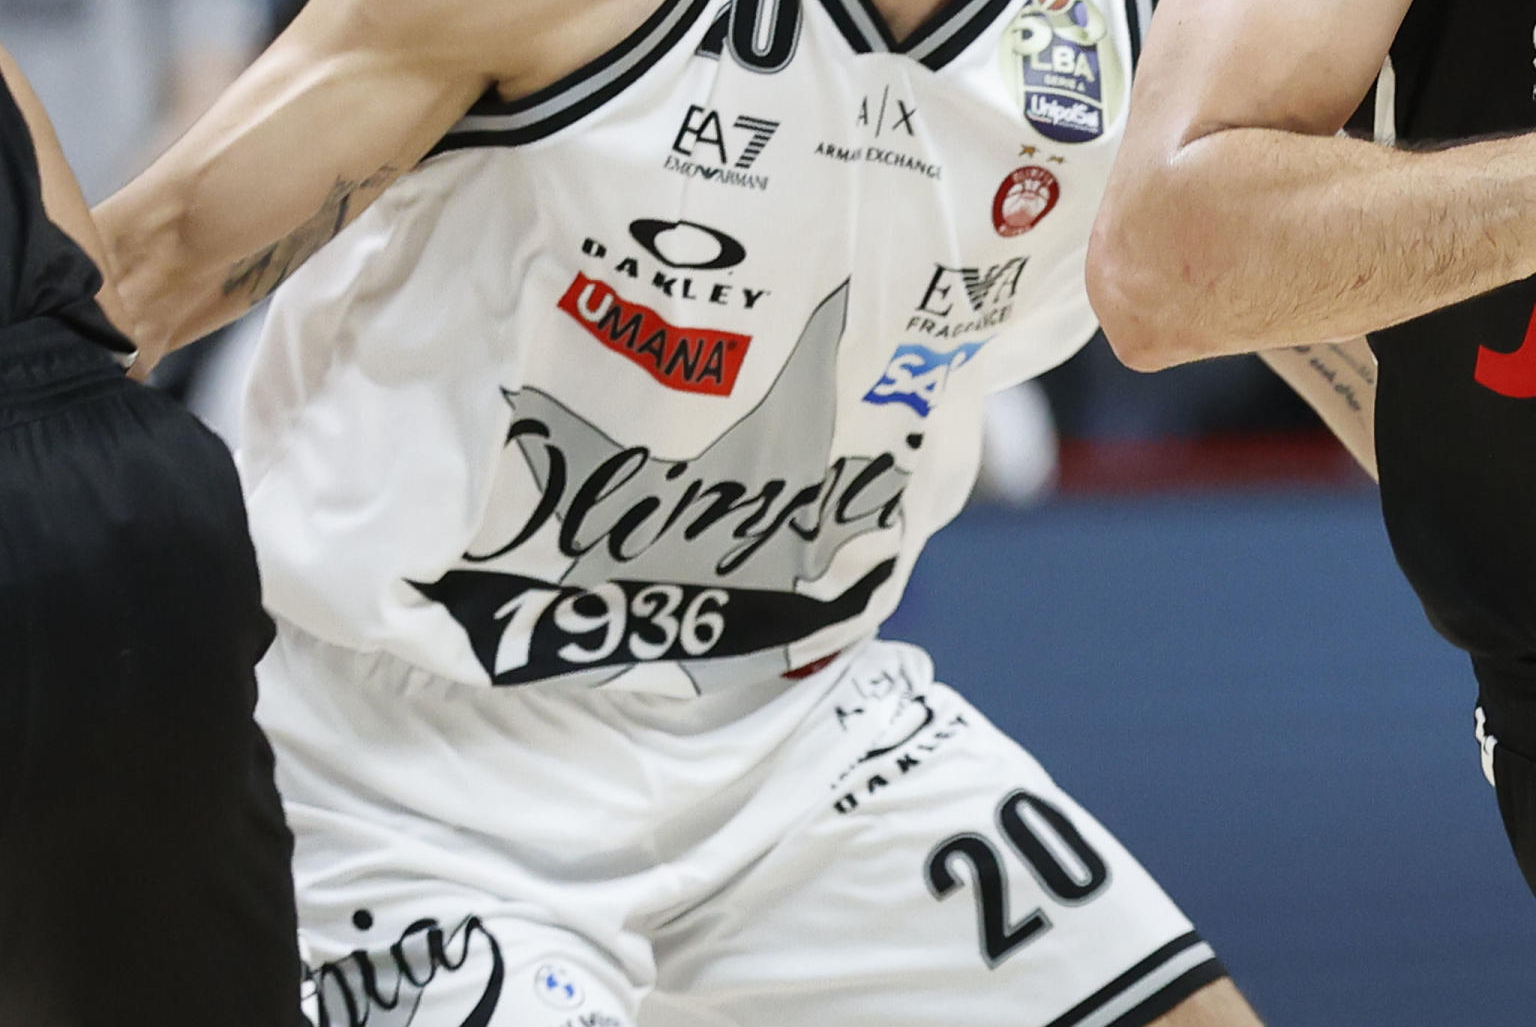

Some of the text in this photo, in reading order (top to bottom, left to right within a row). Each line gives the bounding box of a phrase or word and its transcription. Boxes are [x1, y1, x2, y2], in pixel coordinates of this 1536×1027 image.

[1031, 45, 1096, 83] LBA
[581, 237, 764, 309] OAKLEY
[577, 283, 726, 384] UMANA
[493, 582, 728, 677] 1936
[923, 787, 1113, 971] 20
